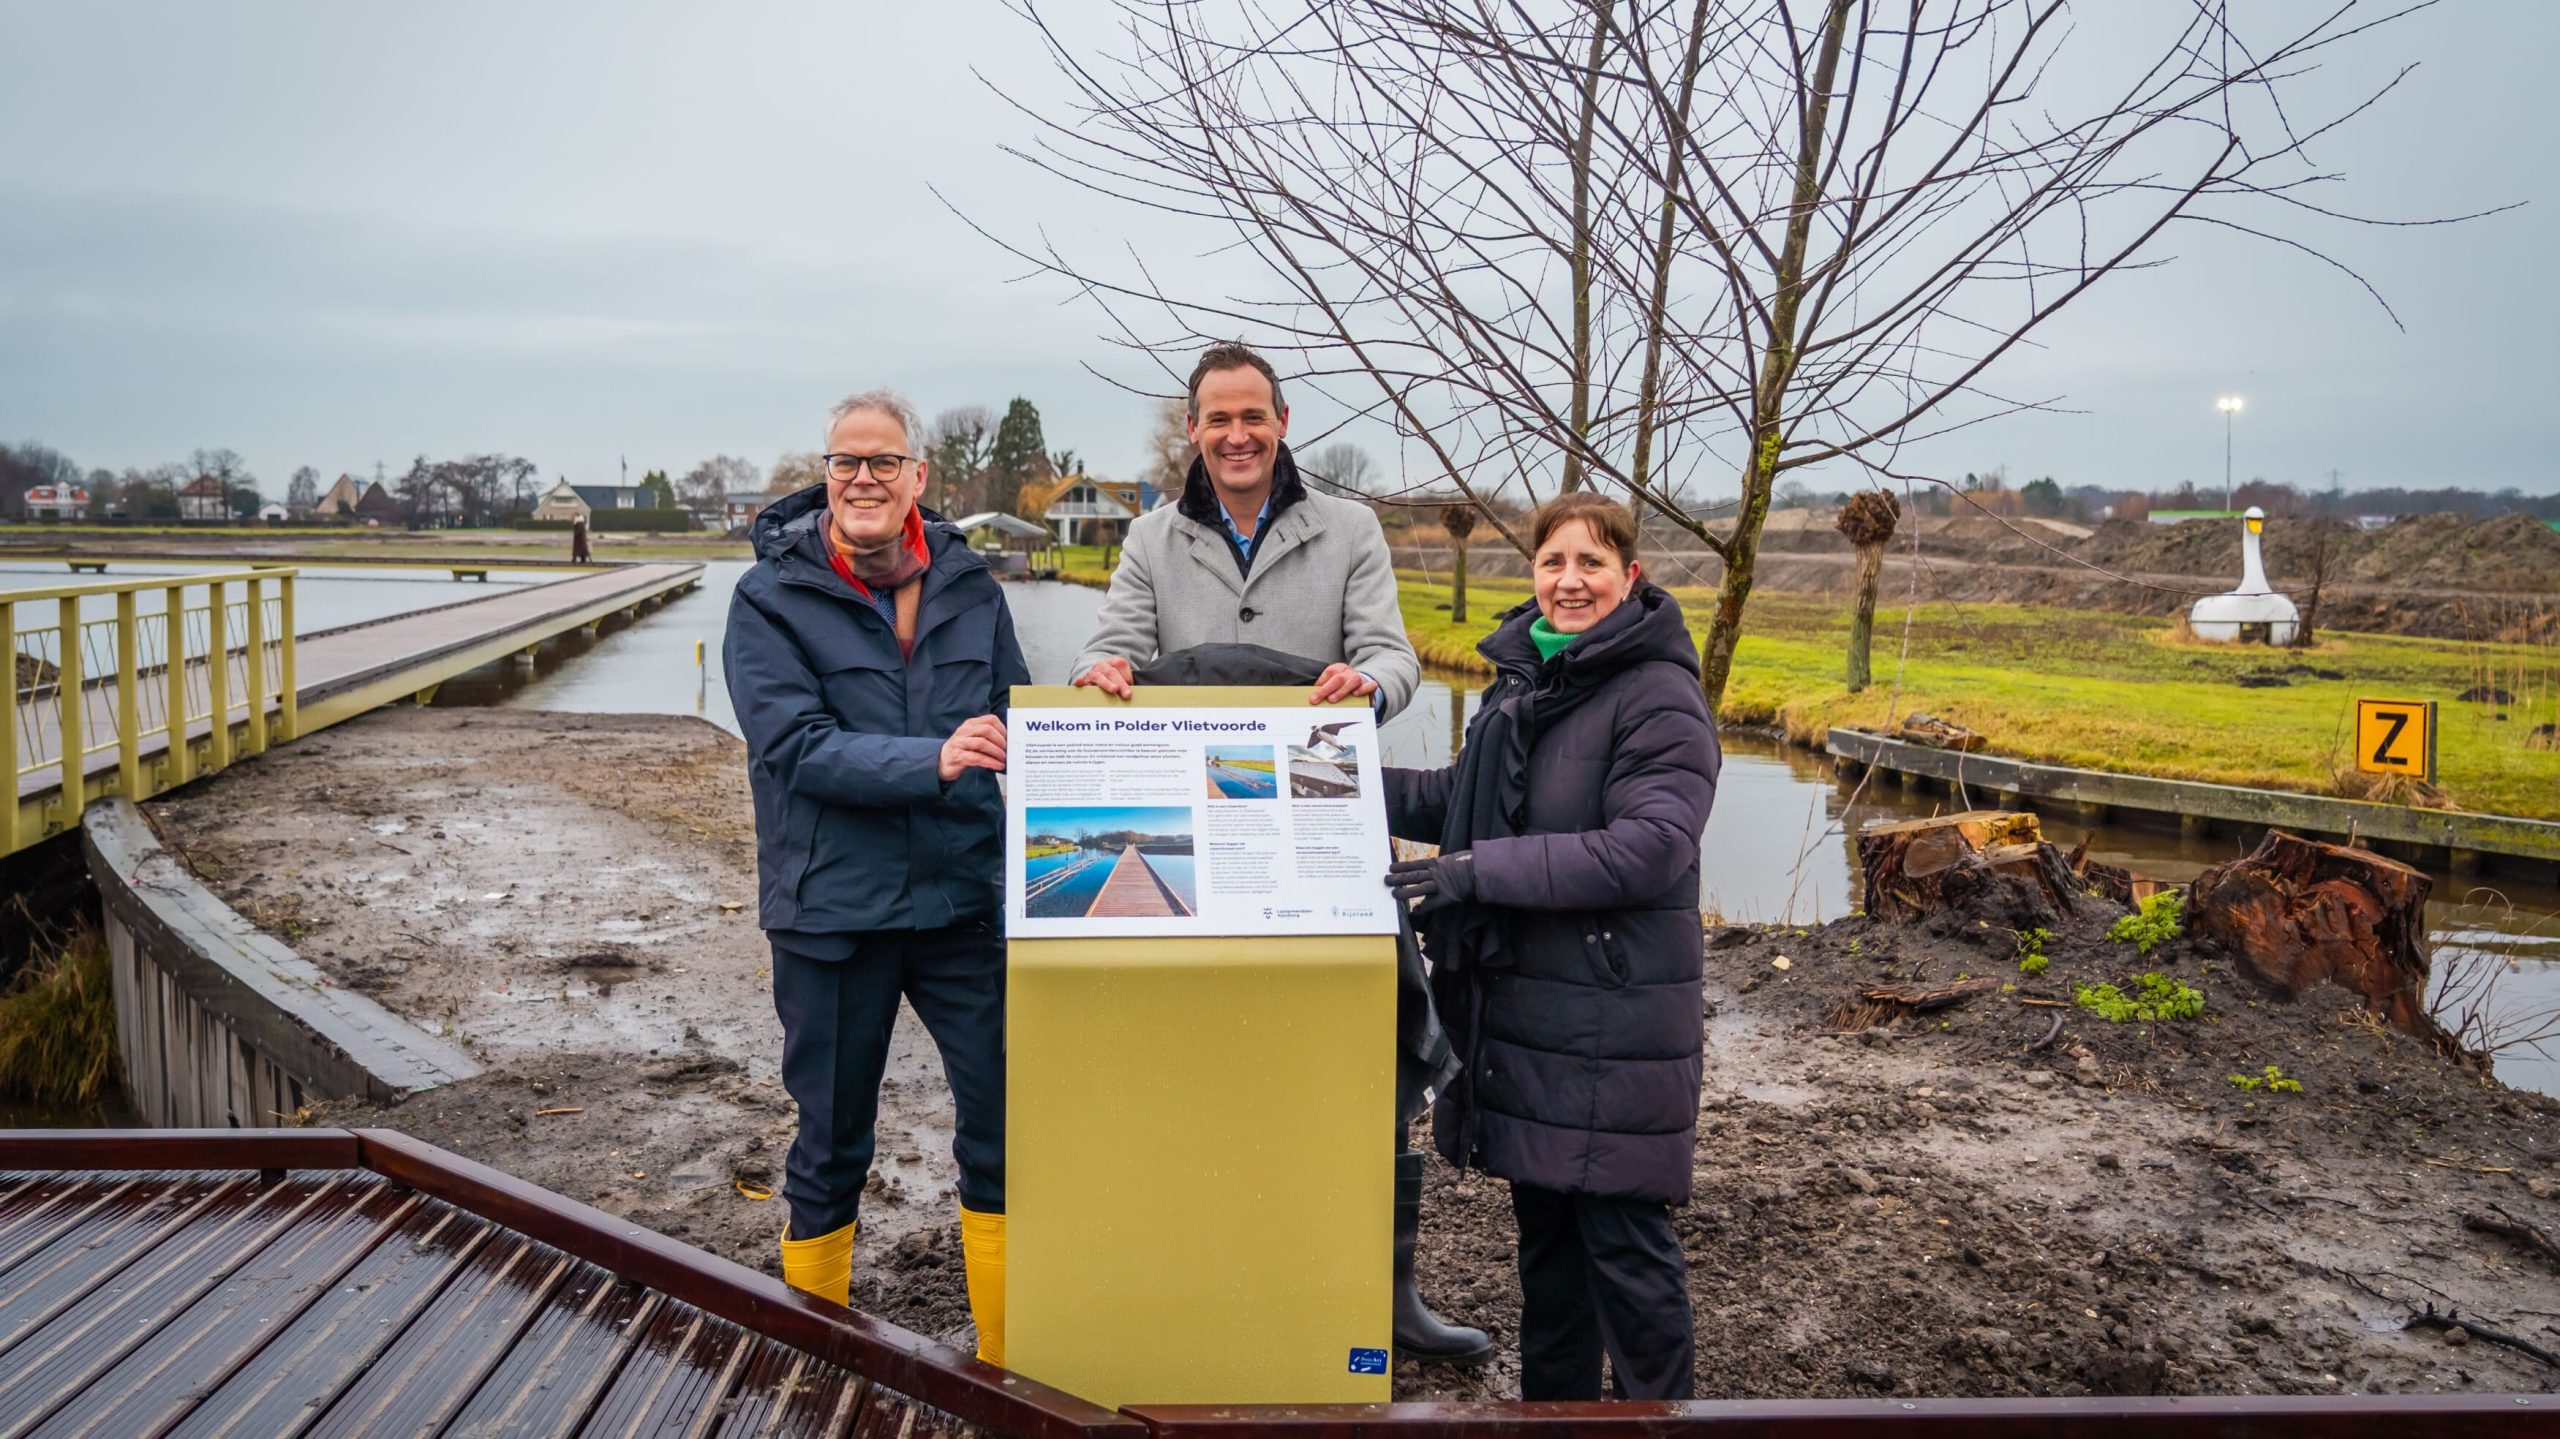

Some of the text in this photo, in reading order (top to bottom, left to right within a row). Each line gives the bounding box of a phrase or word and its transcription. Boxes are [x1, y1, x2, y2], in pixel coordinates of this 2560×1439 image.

[1026, 720, 1266, 732] Welkom in Polder Vlietvoorde
[2373, 712, 2408, 765] Z
